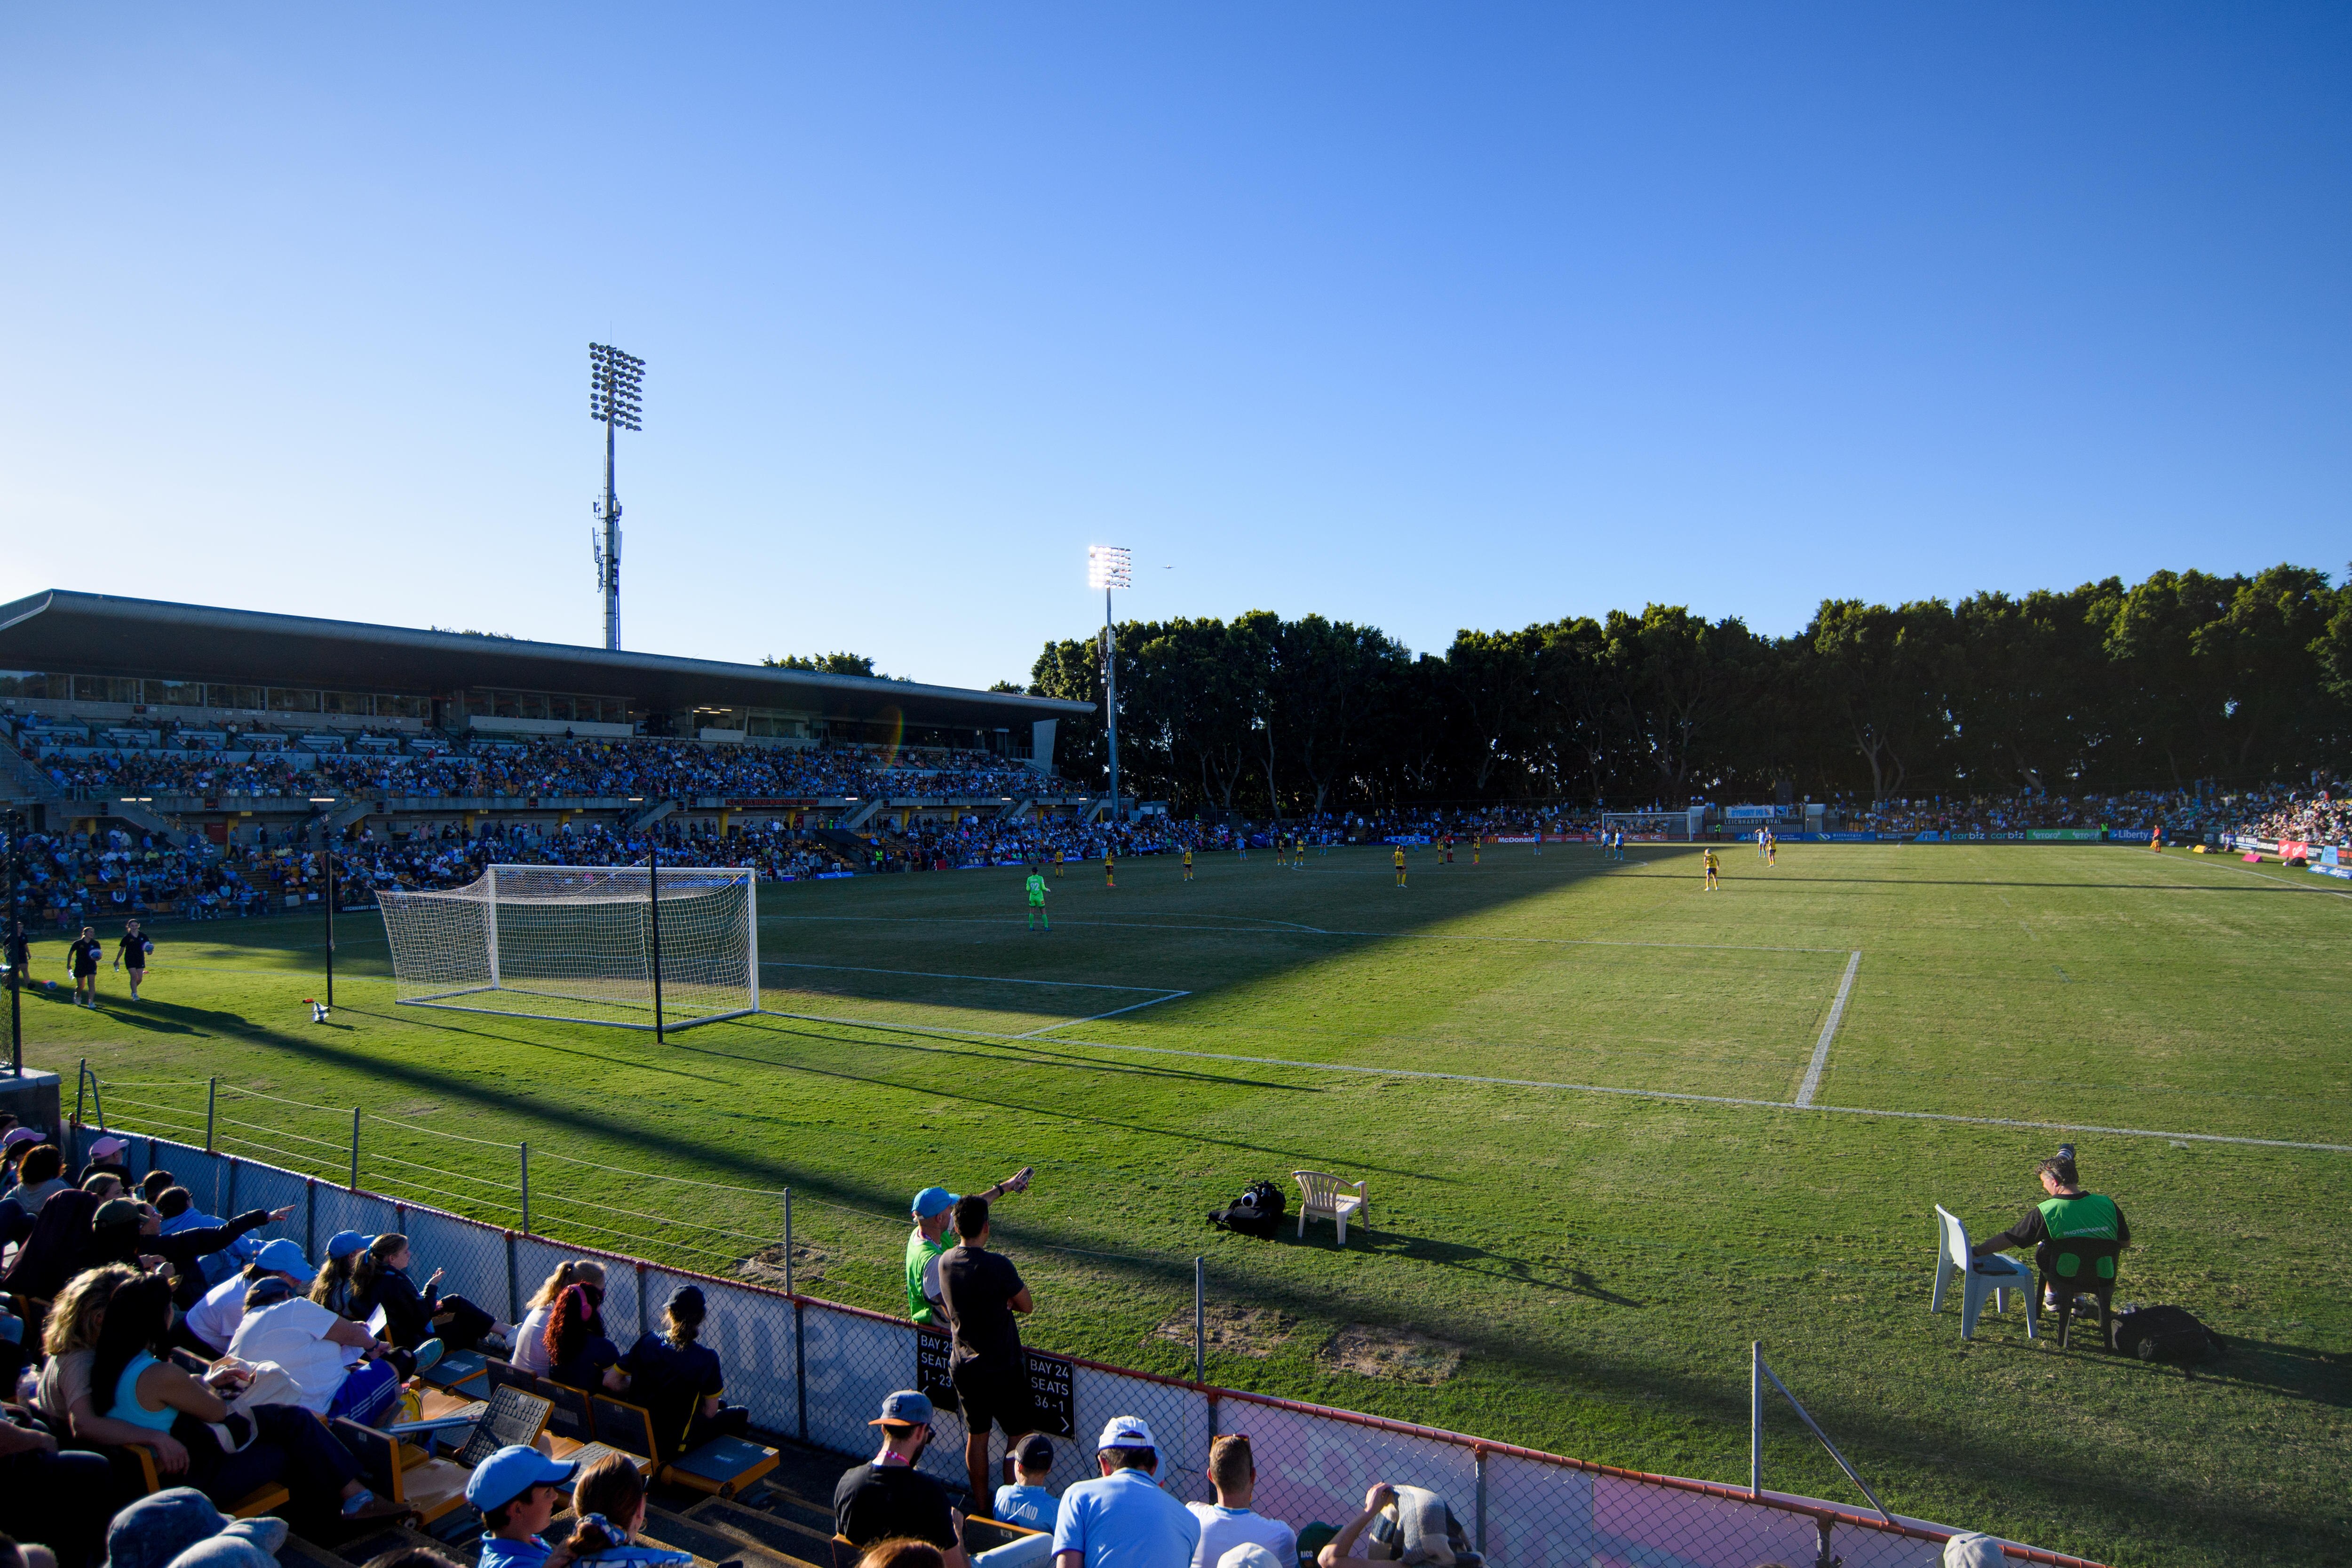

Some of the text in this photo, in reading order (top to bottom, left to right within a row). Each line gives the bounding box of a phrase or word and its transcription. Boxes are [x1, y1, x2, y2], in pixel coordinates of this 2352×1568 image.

[1952, 831, 1985, 840] carbiz
[1991, 830, 2024, 839] carbiz
[2119, 830, 2148, 840] Liberty
[1030, 883, 1040, 891] 92
[2063, 1226, 2109, 1236] PHOTOGRAPHER
[921, 1335, 940, 1350] BAY
[1031, 1359, 1069, 1378] BAY 24
[924, 1369, 929, 1381] 1
[939, 1374, 952, 1387] 23
[1031, 1377, 1069, 1395] SEATS
[1035, 1395, 1049, 1408] 36
[1059, 1401, 1064, 1412] 1
